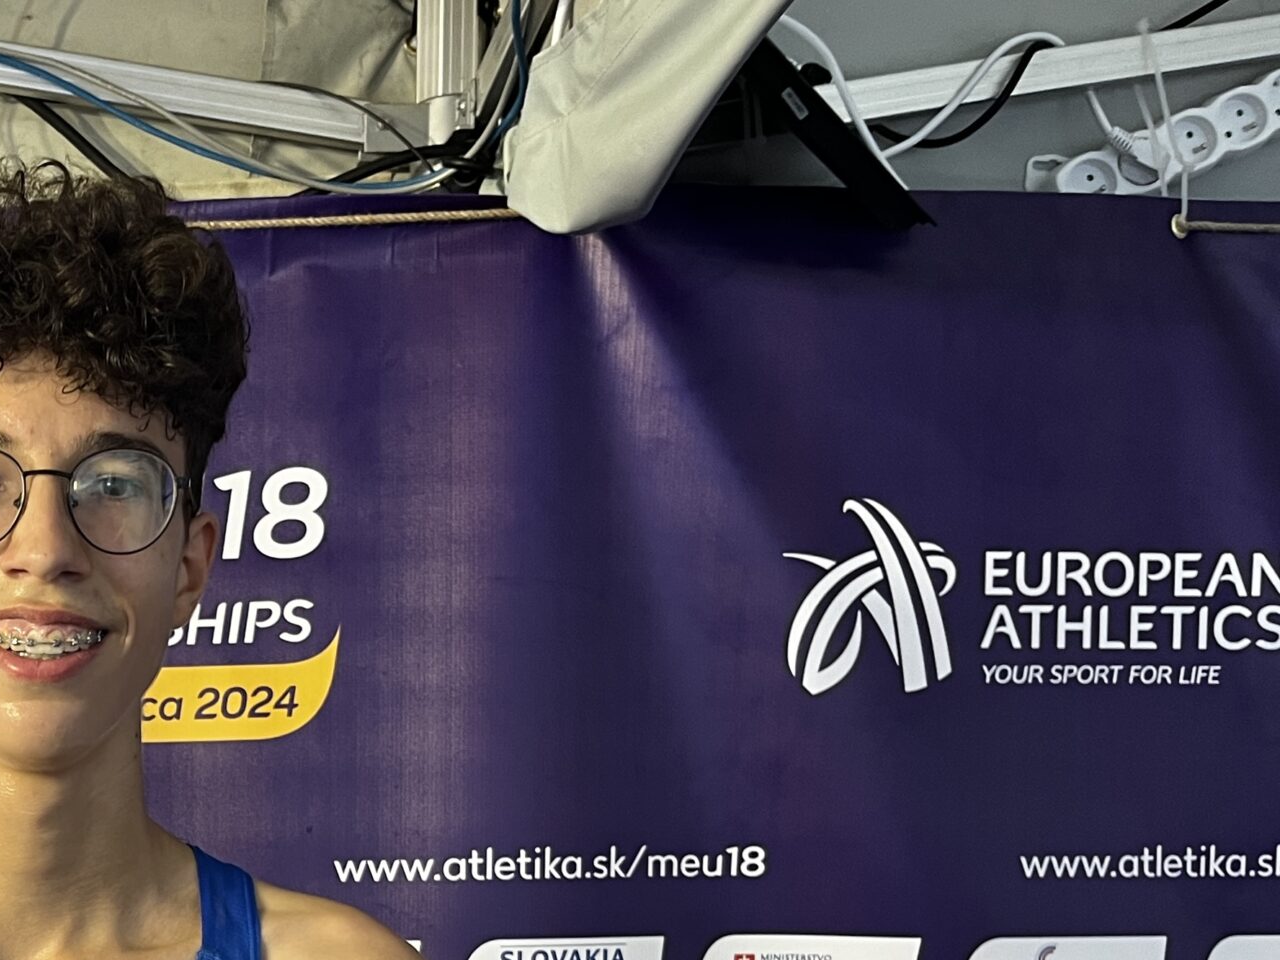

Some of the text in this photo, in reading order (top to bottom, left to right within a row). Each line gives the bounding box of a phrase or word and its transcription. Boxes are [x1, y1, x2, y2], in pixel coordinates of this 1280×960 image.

[212, 467, 329, 560] 18
[982, 664, 1221, 685] YOUR SPORT FOR LIFE
[195, 684, 299, 721] 2024
[333, 845, 767, 883] www.atletika.sk/meu18
